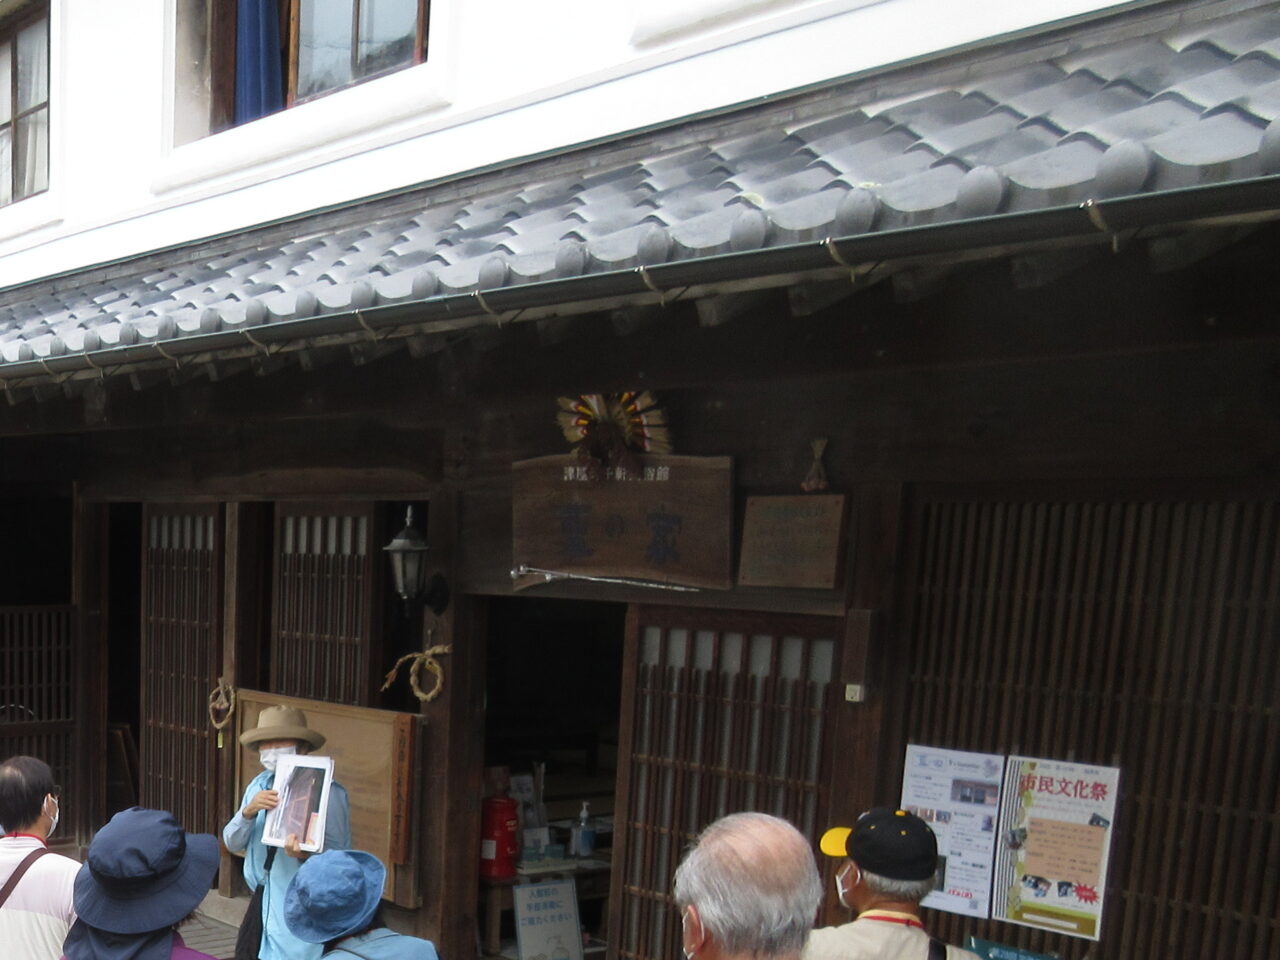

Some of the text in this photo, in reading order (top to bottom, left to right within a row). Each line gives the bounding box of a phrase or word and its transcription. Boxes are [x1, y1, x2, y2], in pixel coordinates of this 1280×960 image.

[1021, 773, 1109, 801] 市民文化祭
